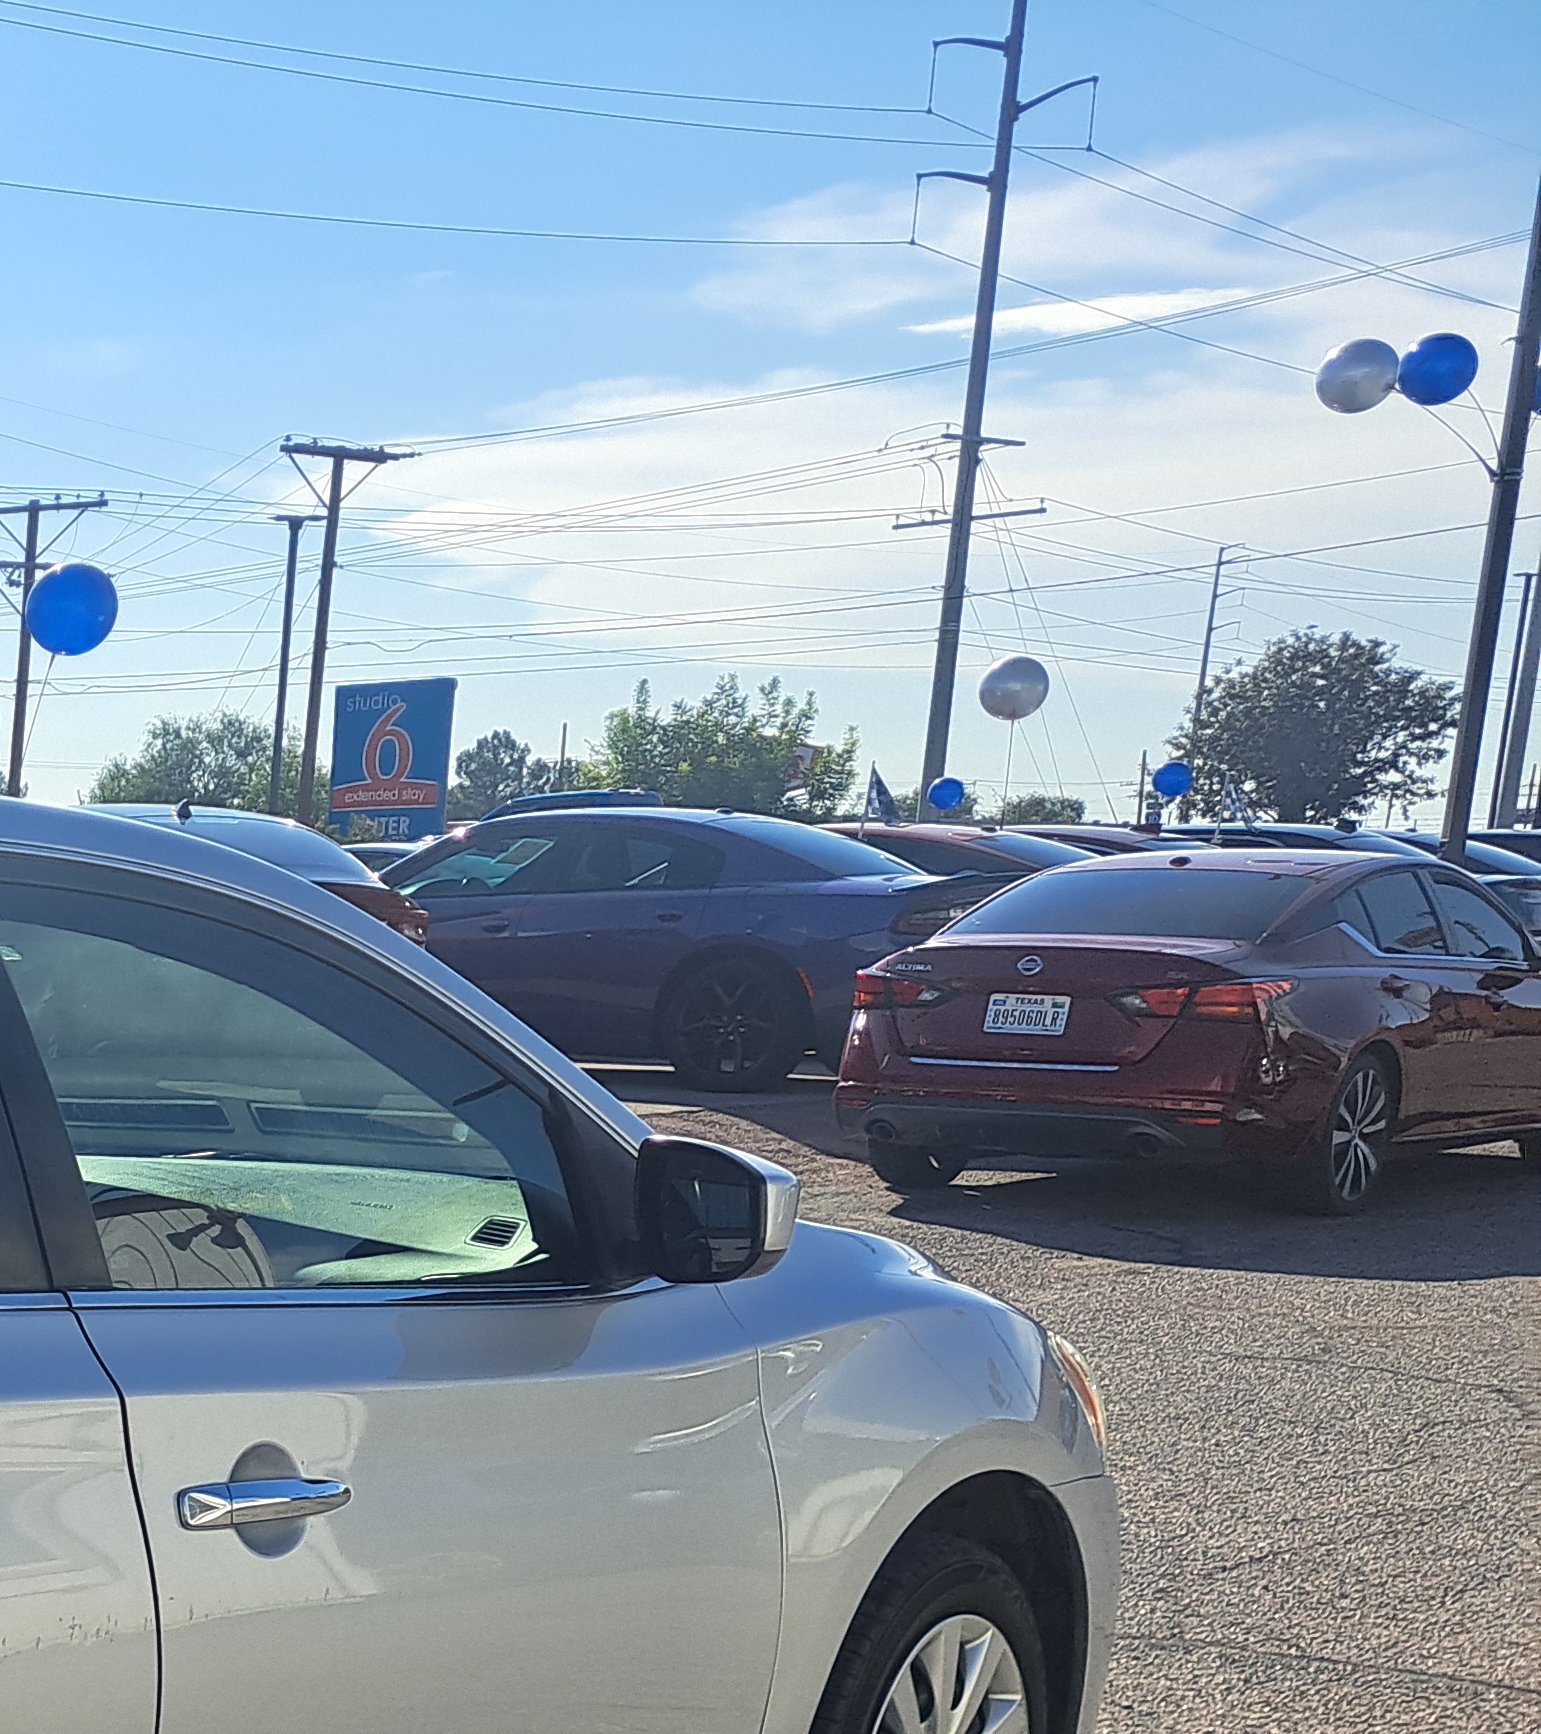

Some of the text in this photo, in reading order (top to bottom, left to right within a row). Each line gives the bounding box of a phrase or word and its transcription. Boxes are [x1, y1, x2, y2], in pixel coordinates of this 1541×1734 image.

[346, 691, 401, 712] studio
[362, 702, 413, 781] 6
[345, 785, 427, 802] extended stay
[895, 963, 933, 972] ALTIMA
[1015, 997, 1046, 1005] TEXAS
[992, 1008, 1060, 1028] 89506DLR
